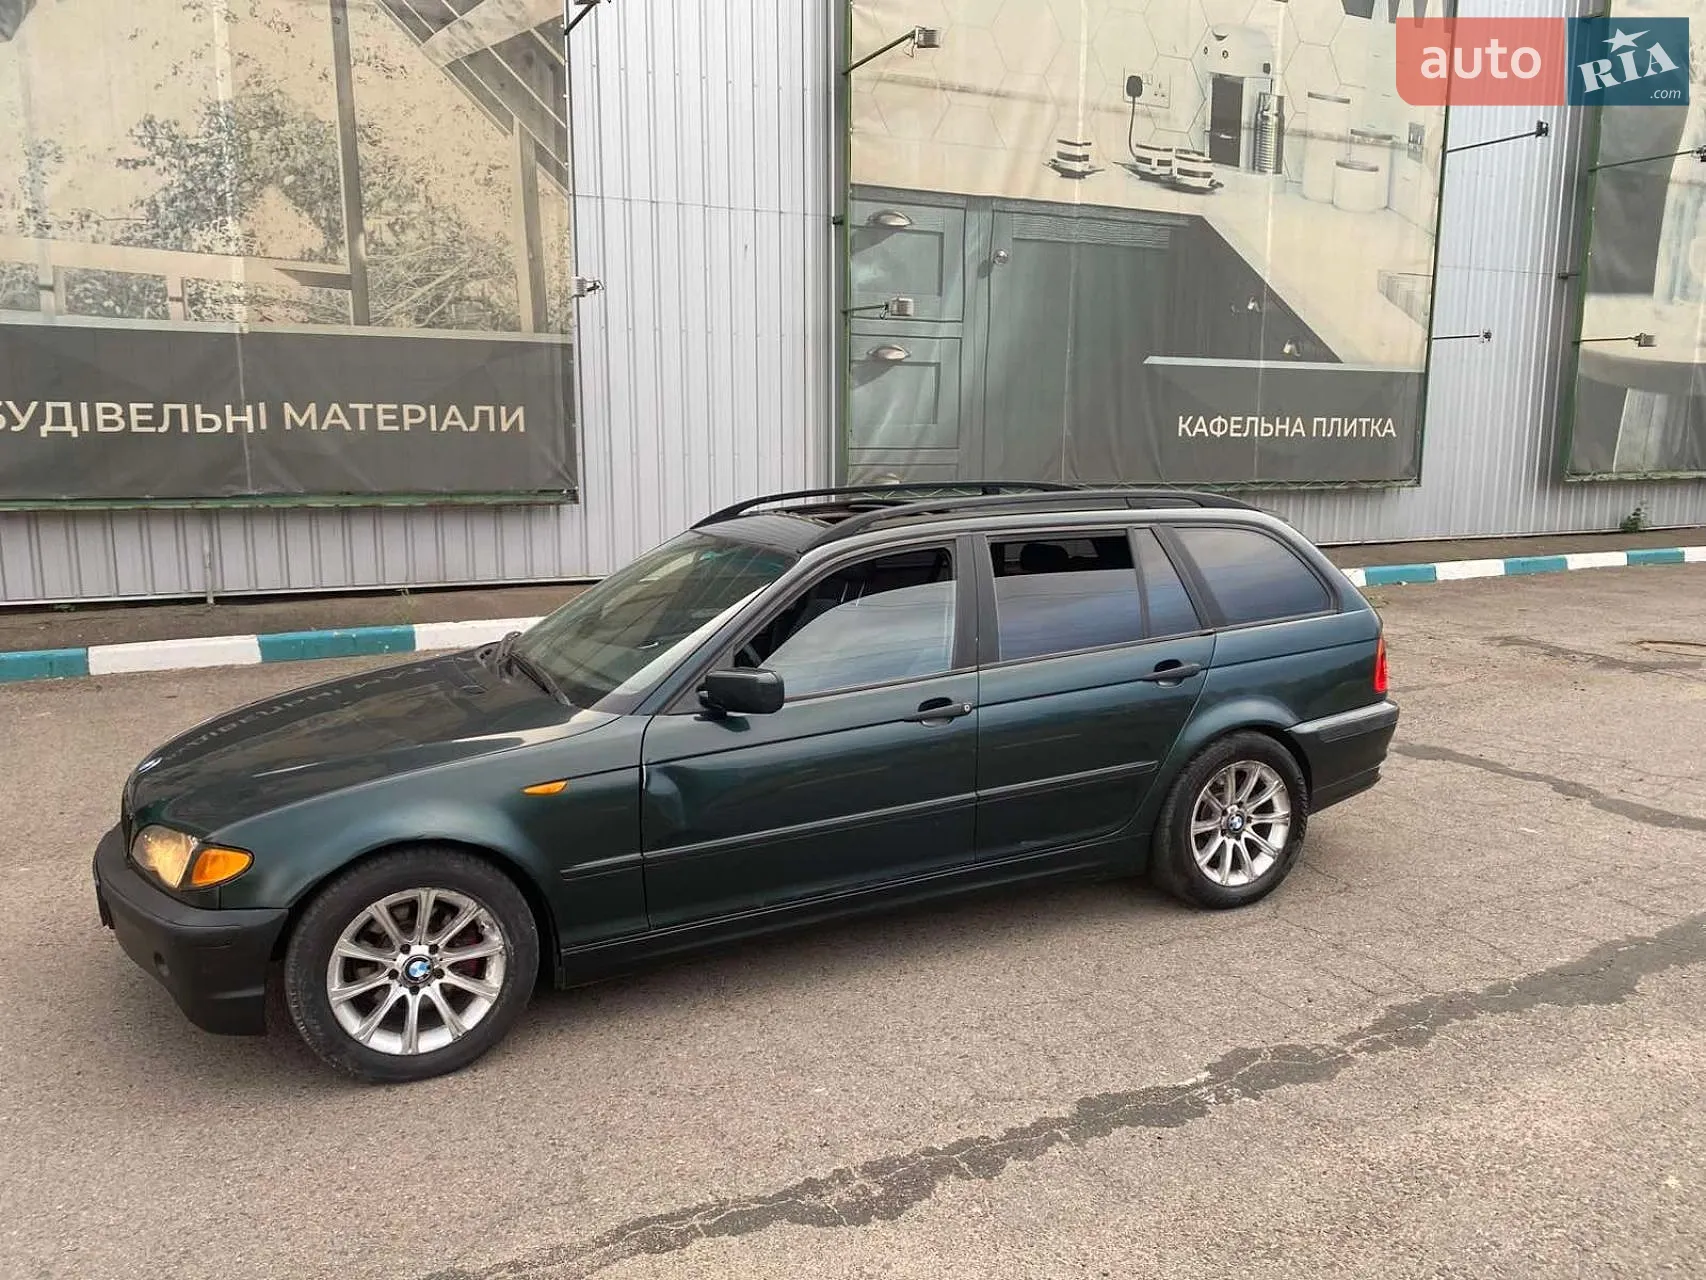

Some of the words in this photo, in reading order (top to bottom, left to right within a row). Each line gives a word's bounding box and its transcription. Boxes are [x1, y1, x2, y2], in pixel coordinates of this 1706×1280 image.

[0, 400, 268, 437] УДІВЕЛЬНІ
[283, 401, 526, 433] МАТЕРІАЛИ
[1178, 415, 1306, 438] КАФЕЛЬНА
[1312, 417, 1397, 438] ПЛИТКА
